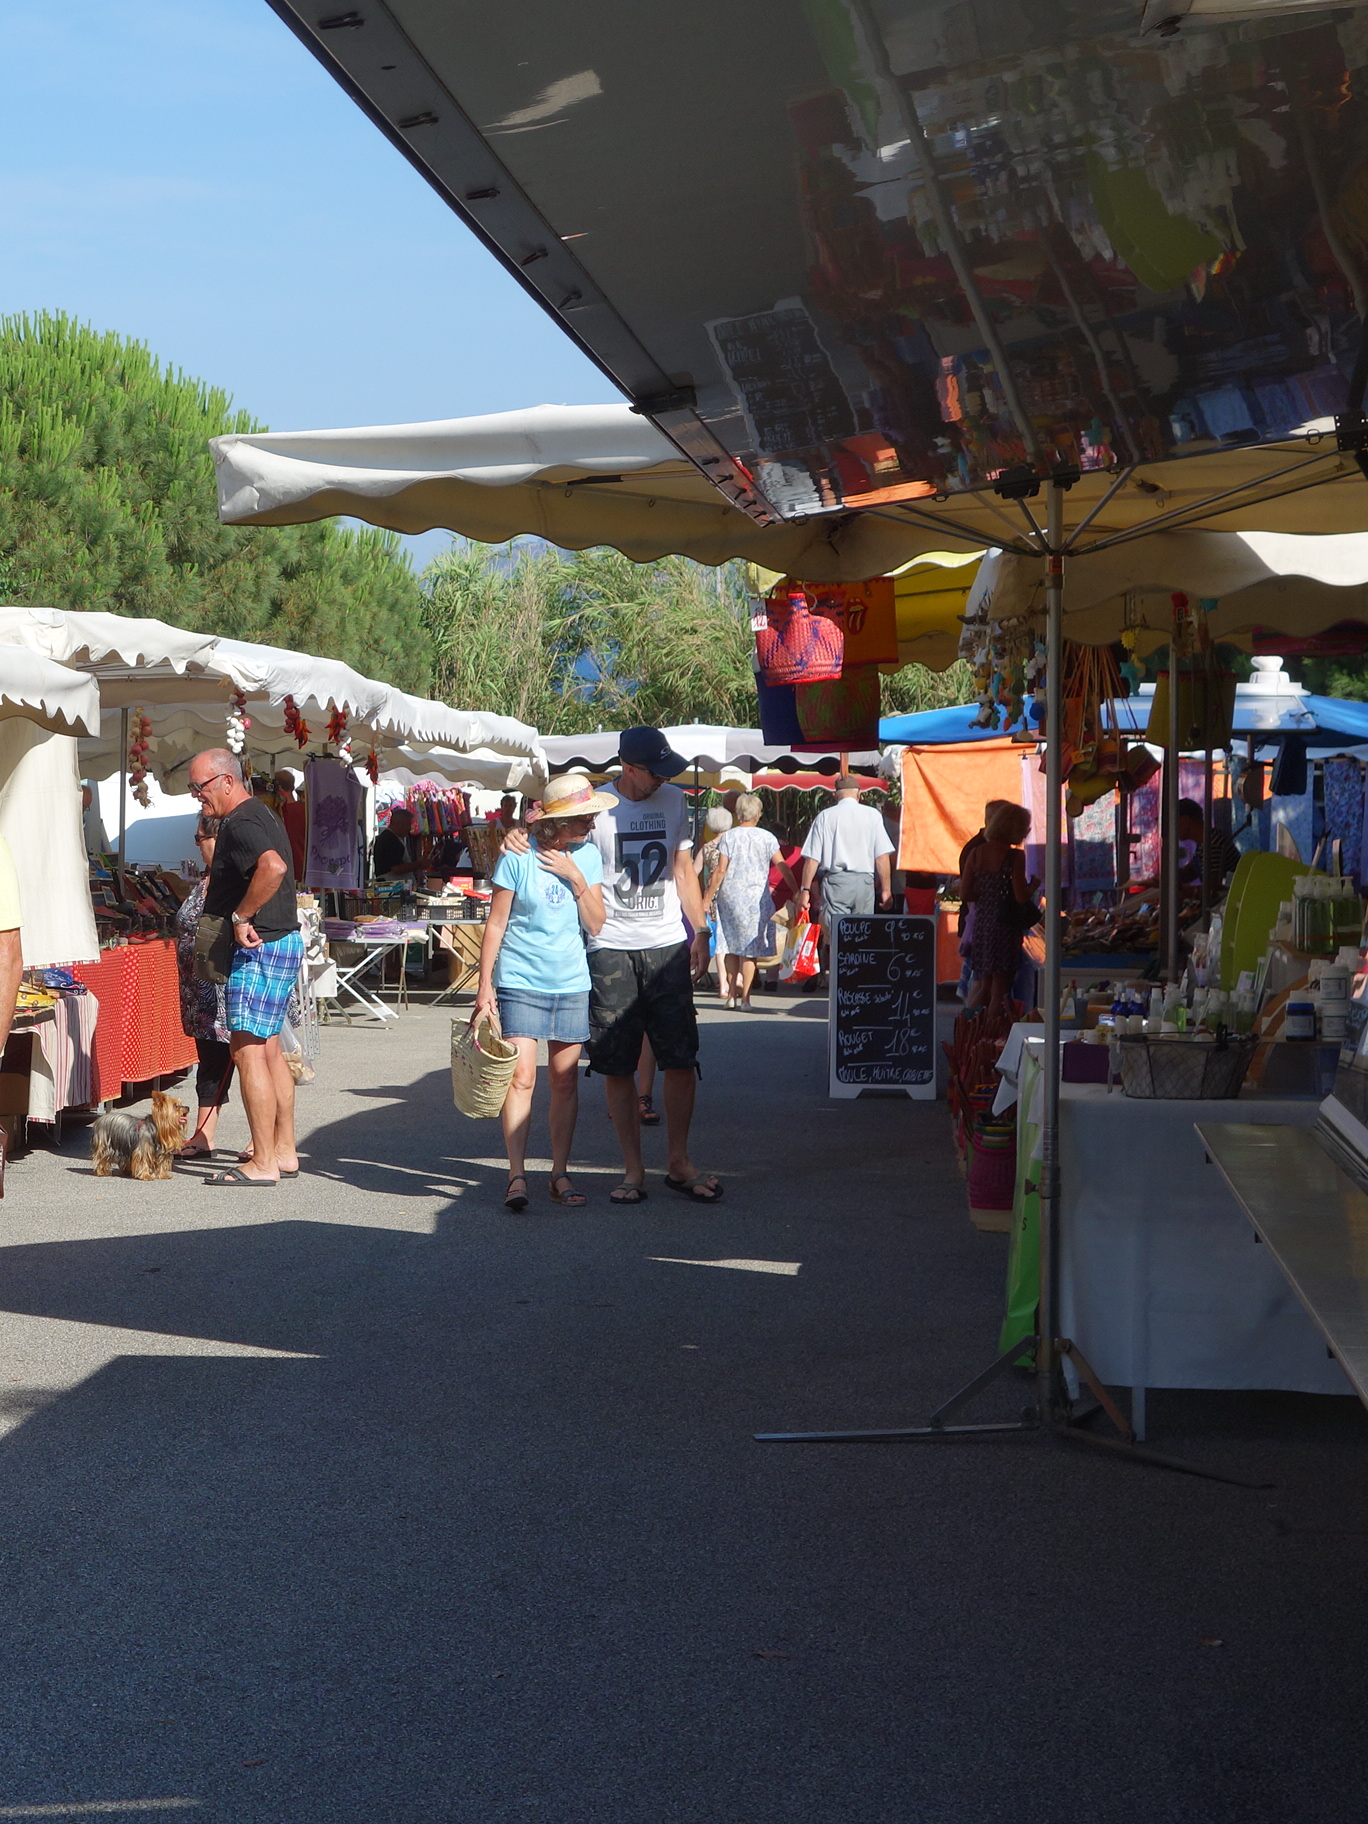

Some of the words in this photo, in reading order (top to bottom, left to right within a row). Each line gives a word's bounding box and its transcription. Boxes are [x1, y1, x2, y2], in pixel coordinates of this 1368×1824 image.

[630, 819, 666, 831] CLOTHING
[613, 830, 668, 899] 52
[839, 920, 871, 935] POULPE
[838, 951, 877, 967] SARDINE
[887, 953, 906, 982] 6
[839, 1030, 873, 1047] ROUGET
[884, 1027, 911, 1056] 18
